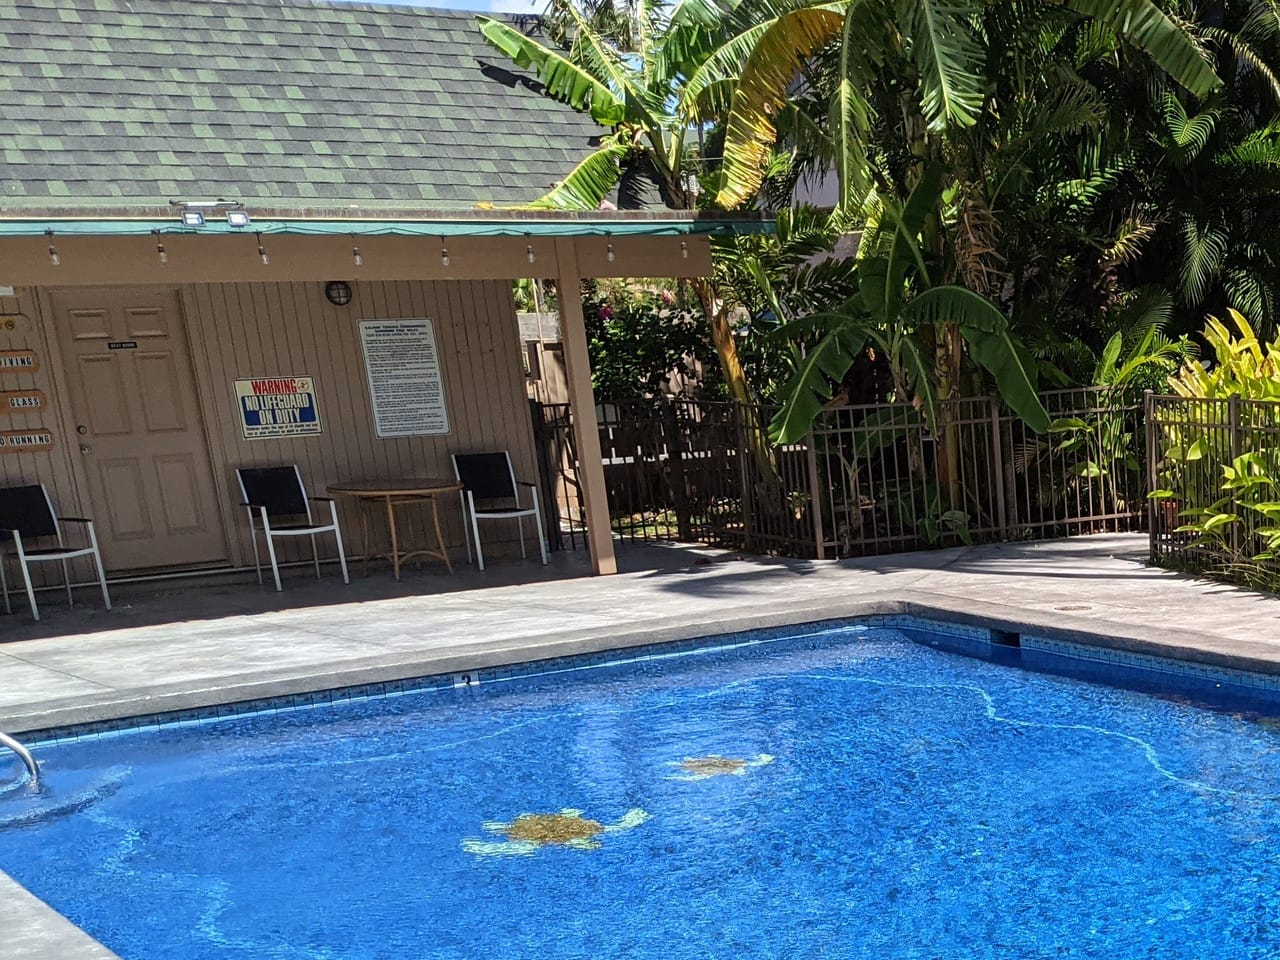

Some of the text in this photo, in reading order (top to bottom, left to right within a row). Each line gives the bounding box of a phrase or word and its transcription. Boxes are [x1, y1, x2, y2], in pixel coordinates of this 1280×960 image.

[0, 357, 32, 366] IVING
[251, 379, 297, 395] WARNING
[10, 397, 40, 408] GLASS
[245, 394, 309, 411] NO LIFEGUARD
[259, 408, 300, 424] ON DUTY
[10, 434, 51, 446] RUNNING
